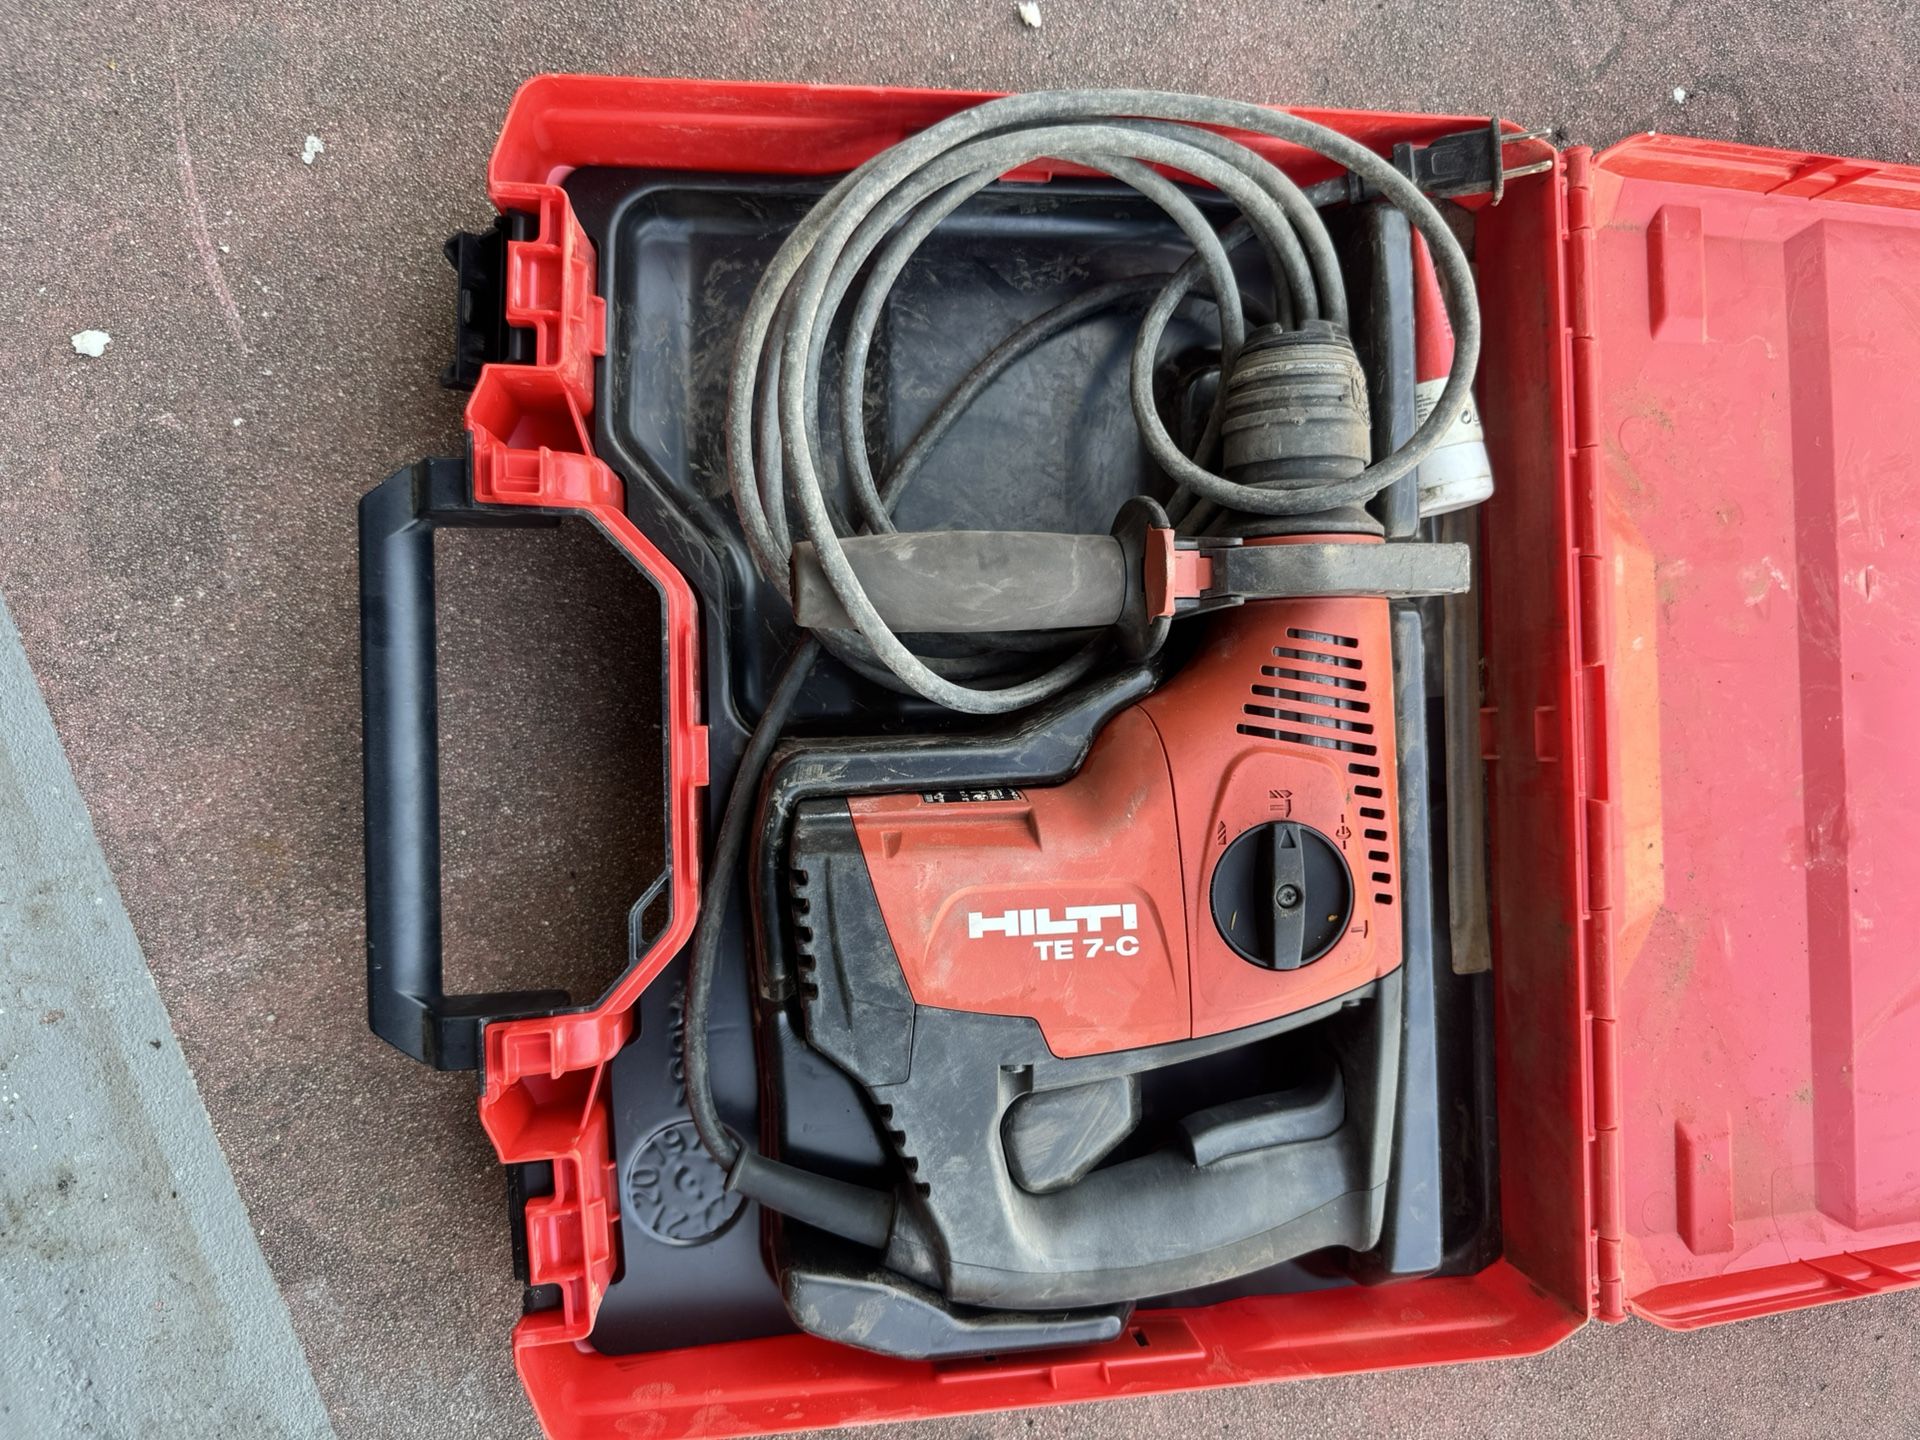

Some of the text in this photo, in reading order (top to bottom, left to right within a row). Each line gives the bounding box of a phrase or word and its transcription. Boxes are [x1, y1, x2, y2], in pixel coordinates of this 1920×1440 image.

[968, 903, 1138, 939] HILTI
[1033, 935, 1140, 961] TE 7-C
